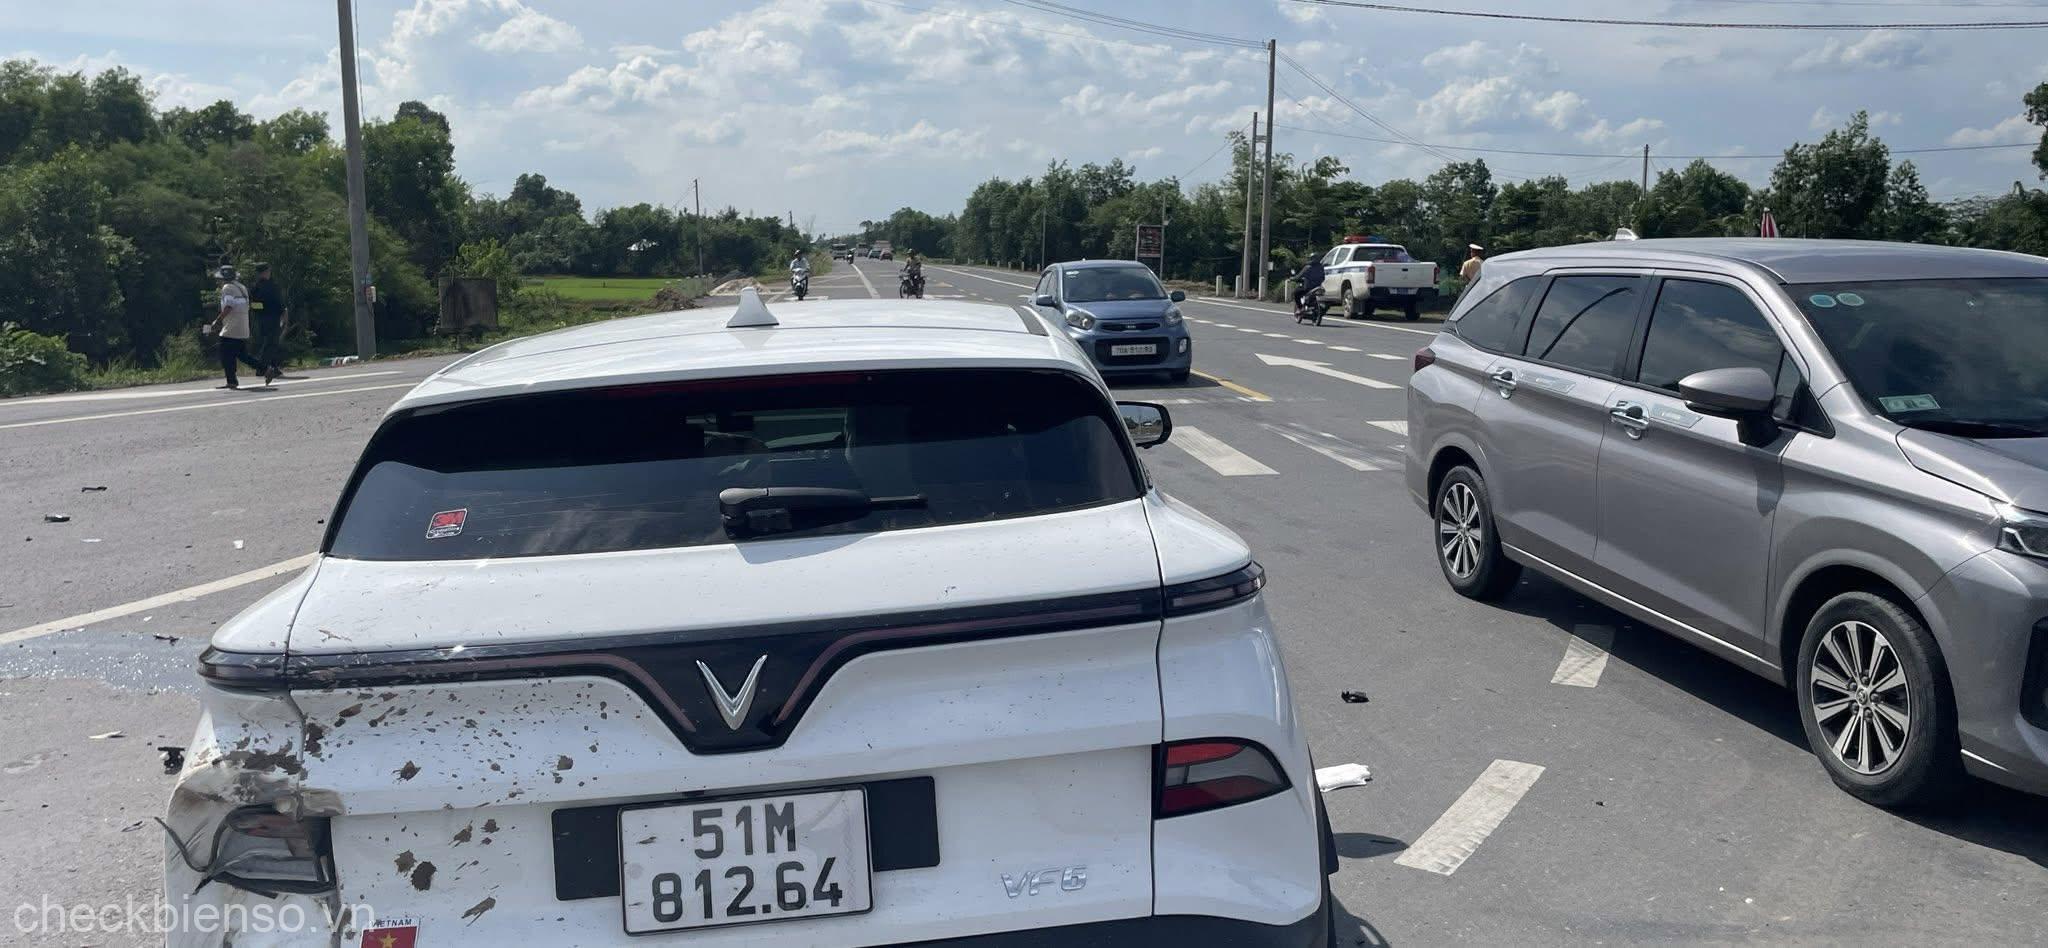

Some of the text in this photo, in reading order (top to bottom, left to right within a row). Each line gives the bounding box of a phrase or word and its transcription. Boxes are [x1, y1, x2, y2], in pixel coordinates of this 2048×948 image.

[692, 802, 796, 860] 51M
[652, 857, 843, 923] 812.64
[1000, 866, 1087, 899] VF6
